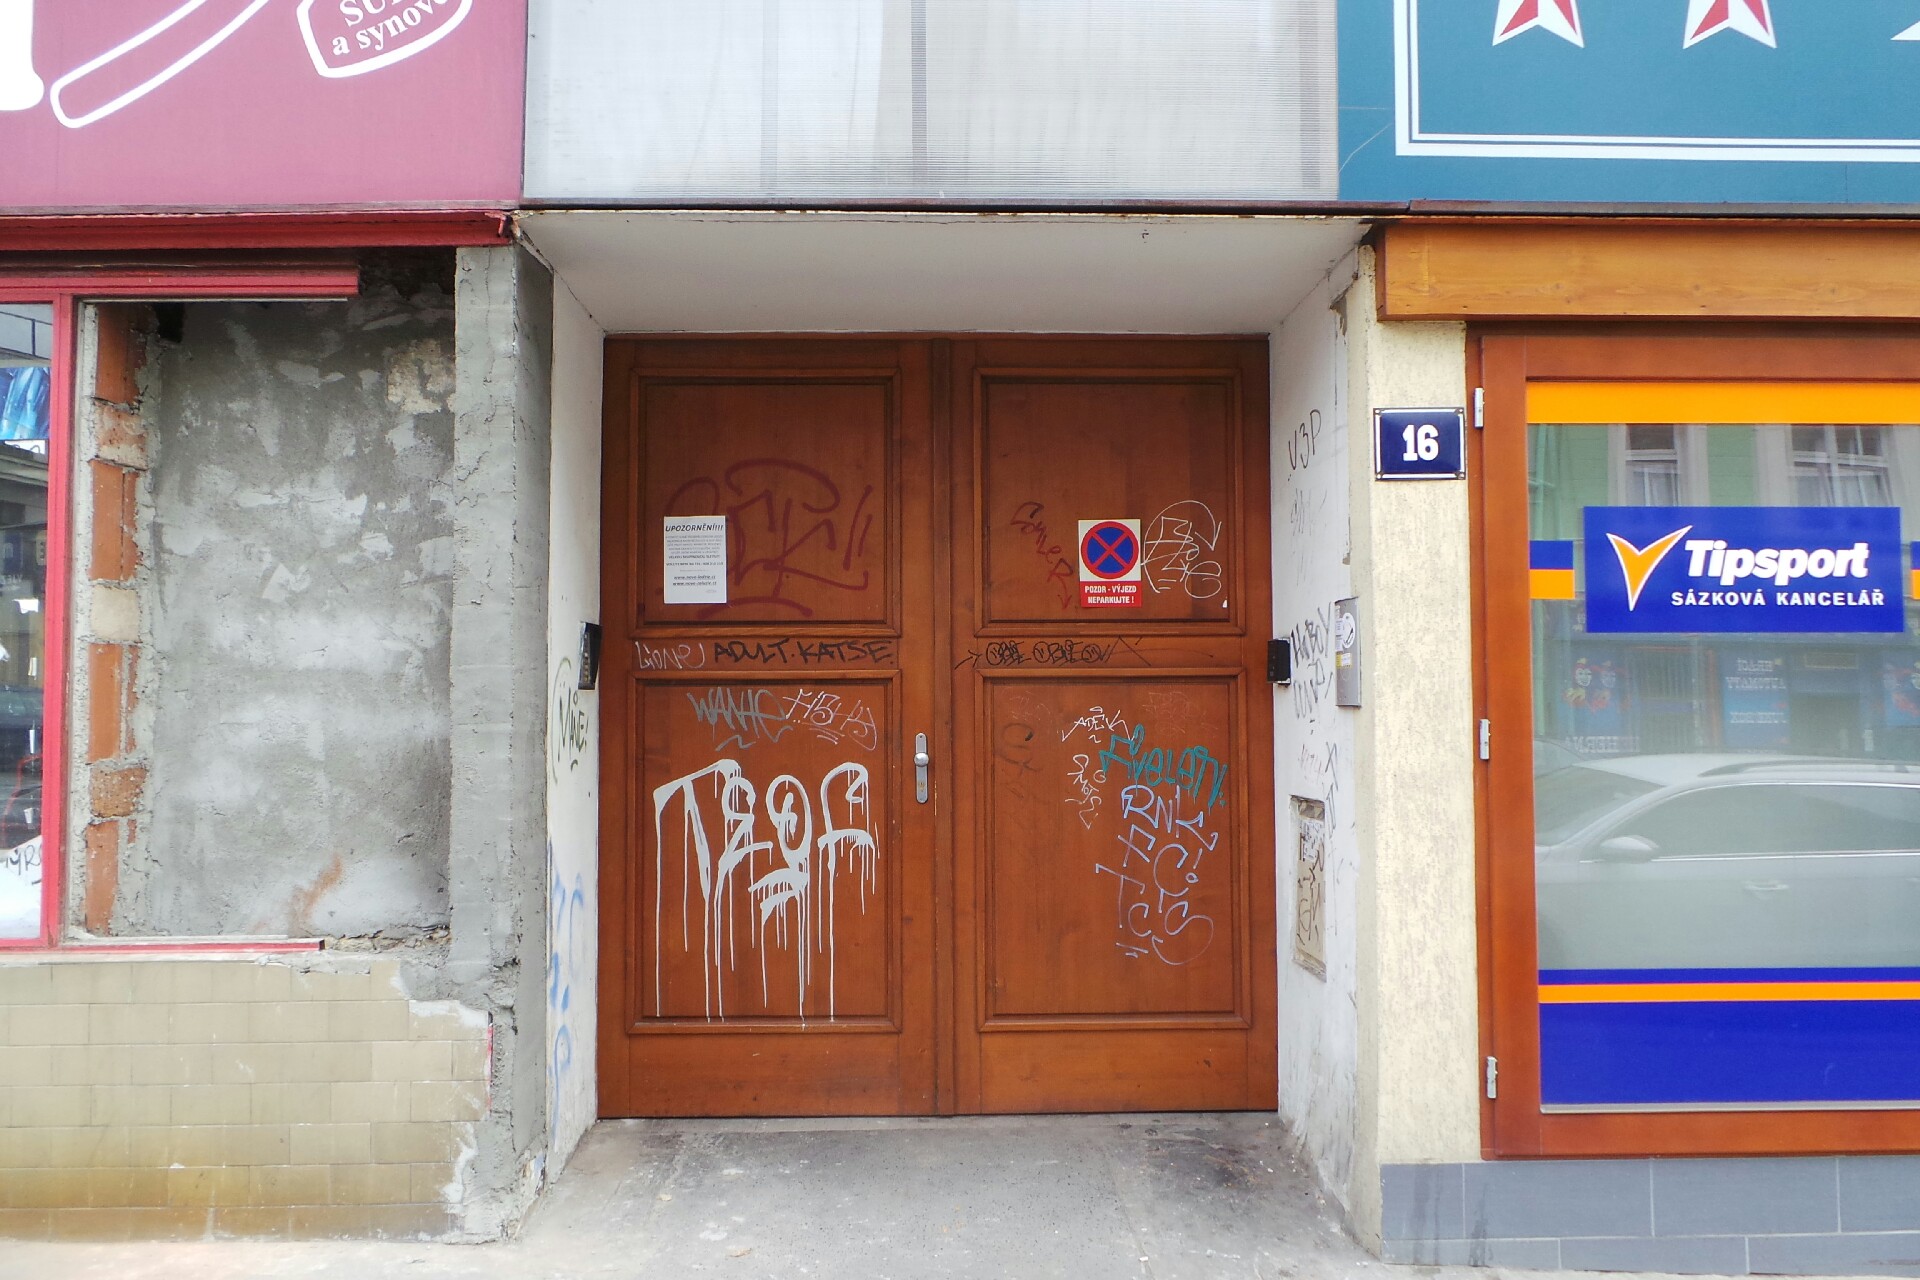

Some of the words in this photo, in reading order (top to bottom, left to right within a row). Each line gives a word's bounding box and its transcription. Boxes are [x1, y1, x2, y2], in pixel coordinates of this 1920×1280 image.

[332, 36, 350, 55] a
[355, 0, 449, 51] synov
[1402, 424, 1440, 462] 16
[1685, 539, 1869, 586] Tipsport
[1084, 585, 1107, 594] POZOR
[1112, 583, 1137, 594] VÝJEZD
[1087, 595, 1130, 604] NEPARKUJTE
[1671, 588, 1767, 607] SÁZKOVÁ
[1776, 588, 1885, 607] KANCELÁŘ
